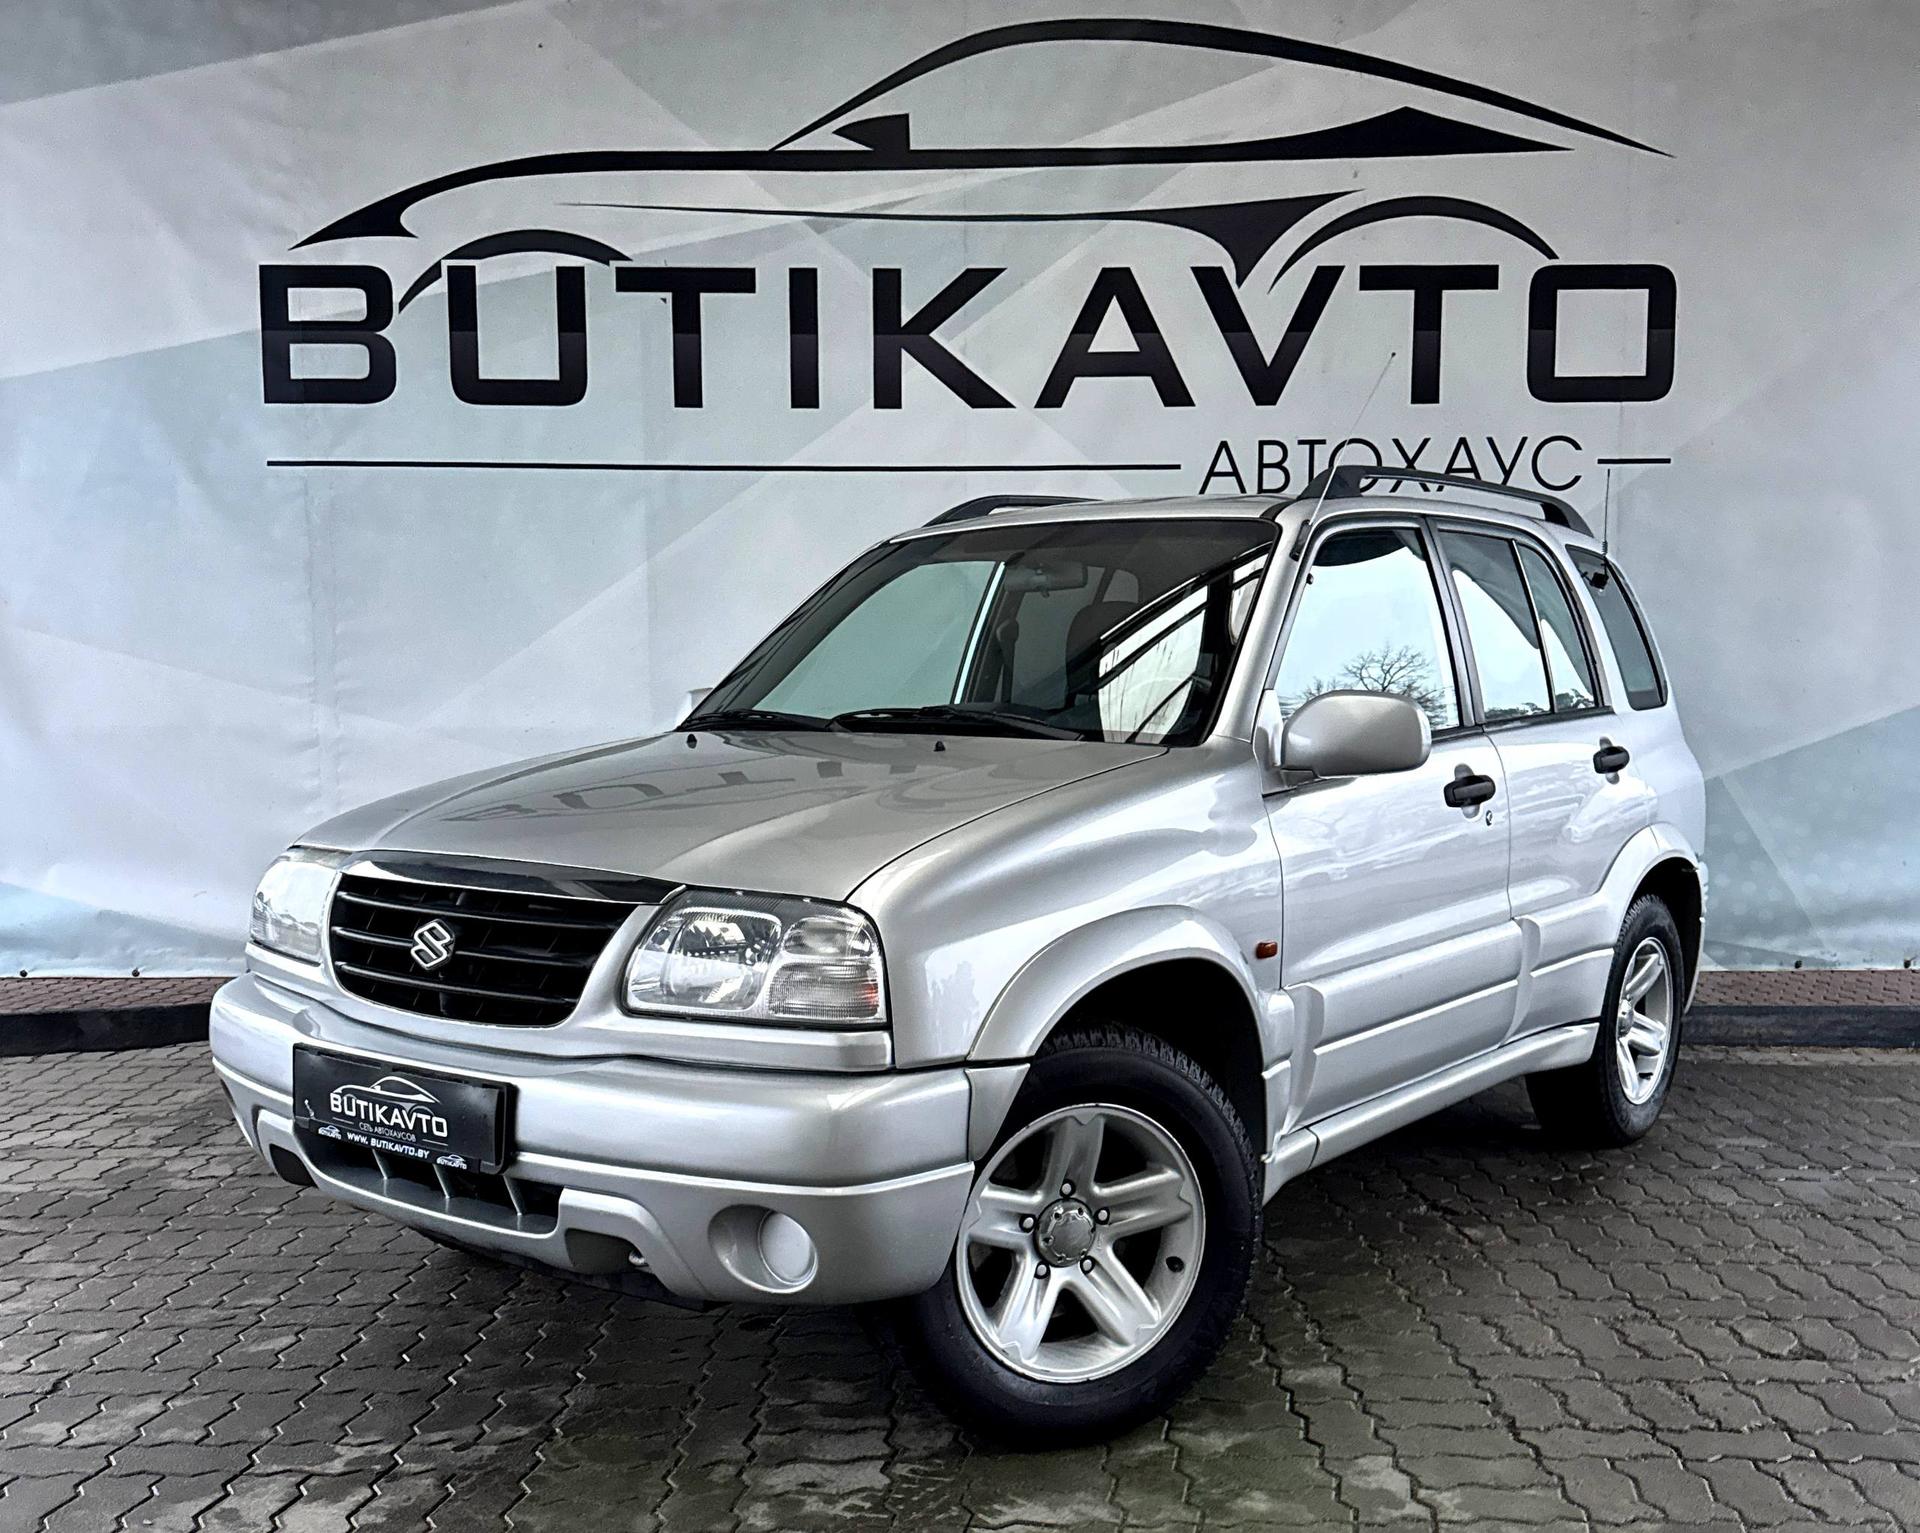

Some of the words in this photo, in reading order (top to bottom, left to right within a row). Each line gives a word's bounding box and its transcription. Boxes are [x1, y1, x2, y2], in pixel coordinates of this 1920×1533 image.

[259, 264, 1677, 408] BUTIKAVTO
[1199, 435, 1583, 495] АВТОХАУС
[330, 1092, 448, 1138] BUTIKAVTO
[346, 1131, 369, 1145] WWW.
[370, 1137, 430, 1159] BUTIKAVTO.BY
